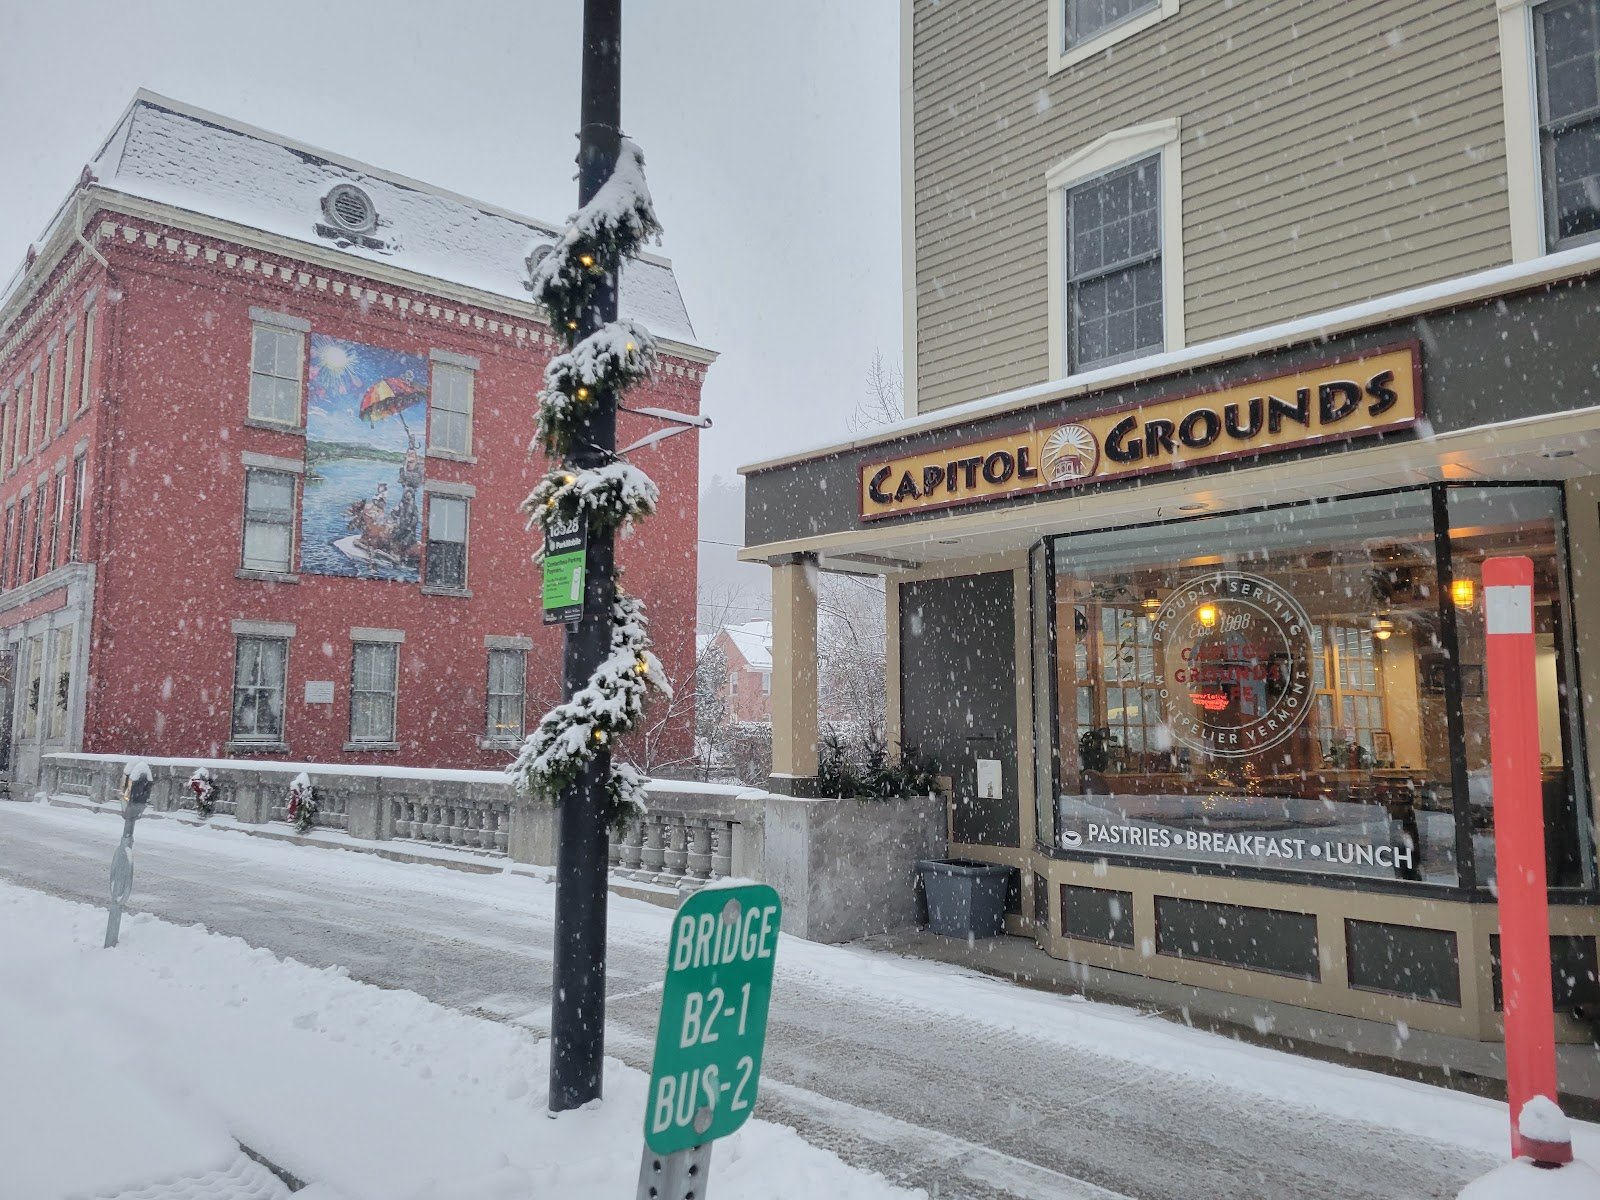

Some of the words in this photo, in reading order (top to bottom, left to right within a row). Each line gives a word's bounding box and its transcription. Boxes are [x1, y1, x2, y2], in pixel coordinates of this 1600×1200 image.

[869, 446, 1038, 503] CAPITOL
[1104, 369, 1398, 463] GROUNDS
[1154, 582, 1218, 642] PROUDLY
[1230, 581, 1301, 636] SERVING
[1175, 665, 1281, 683] GROUNDS
[1155, 675, 1238, 744] MONTPELIER
[1246, 671, 1306, 744] VERMONT
[1088, 823, 1171, 848] PASTRIES
[1186, 832, 1306, 860] BREAKFAST
[1325, 841, 1413, 870] LUNCH
[673, 906, 777, 972] BRIDGE
[679, 983, 751, 1049] B2-1
[653, 1056, 753, 1134] BUS-2
